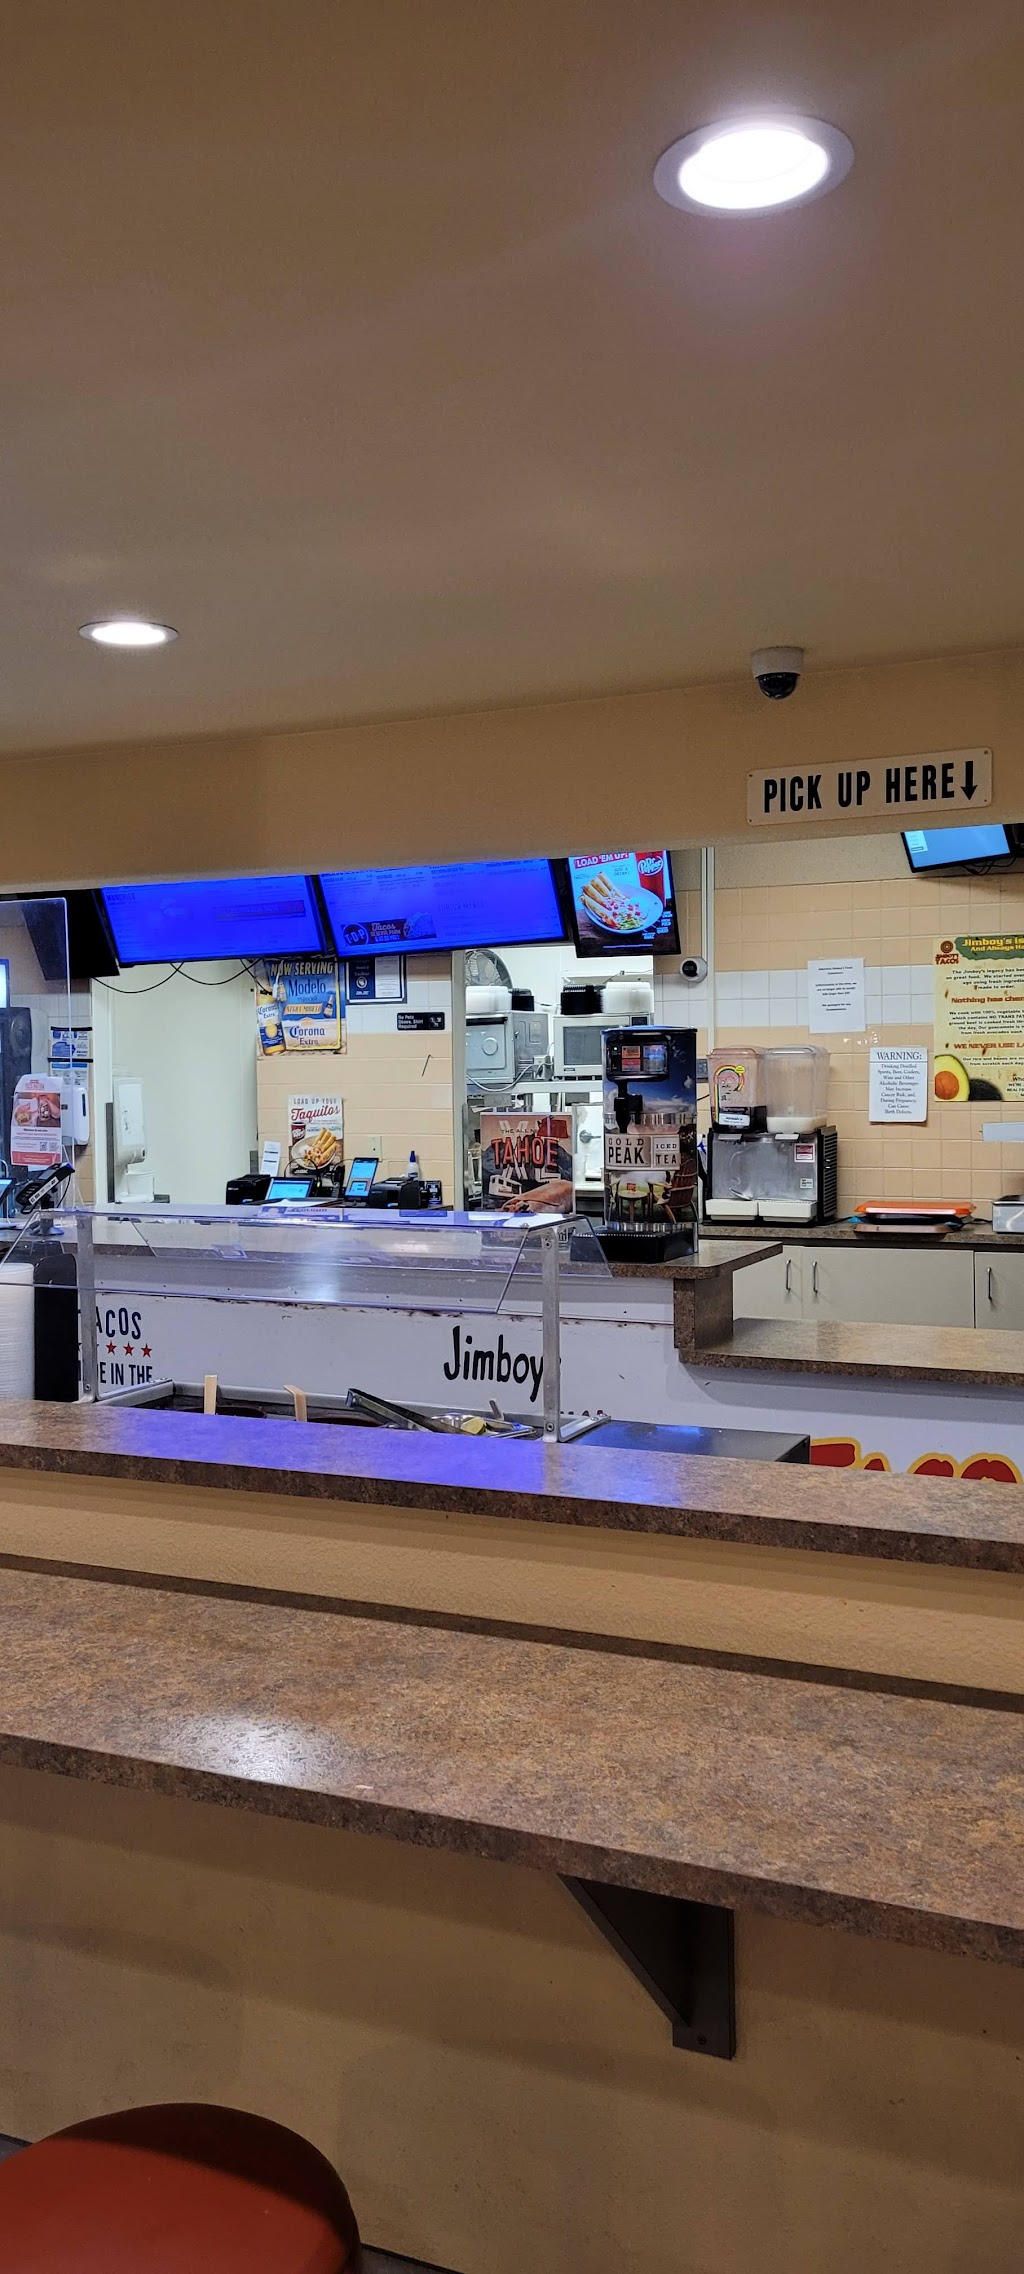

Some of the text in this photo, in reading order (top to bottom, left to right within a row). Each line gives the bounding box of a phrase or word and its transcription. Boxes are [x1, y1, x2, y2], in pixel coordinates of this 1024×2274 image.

[763, 762, 955, 814] PICK UP HERE
[577, 856, 599, 868] LOAD
[640, 860, 663, 874] Pepper
[371, 923, 396, 931] Tacos
[962, 937, 1012, 947] Jimboy's
[271, 962, 333, 976] NOW SERVING
[289, 978, 326, 997] Modelo
[258, 1004, 278, 1015] Corona
[290, 1026, 325, 1039] Corona
[300, 1038, 319, 1046] Extra
[877, 1052, 922, 1060] WARNING:
[291, 1105, 341, 1122] Taquitos
[608, 1138, 645, 1146] GOLD
[491, 1136, 558, 1168] TAHOE
[608, 1146, 645, 1164] PEAK
[656, 1154, 677, 1164] TEA
[111, 1363, 124, 1386] IN
[129, 1364, 153, 1386] THE
